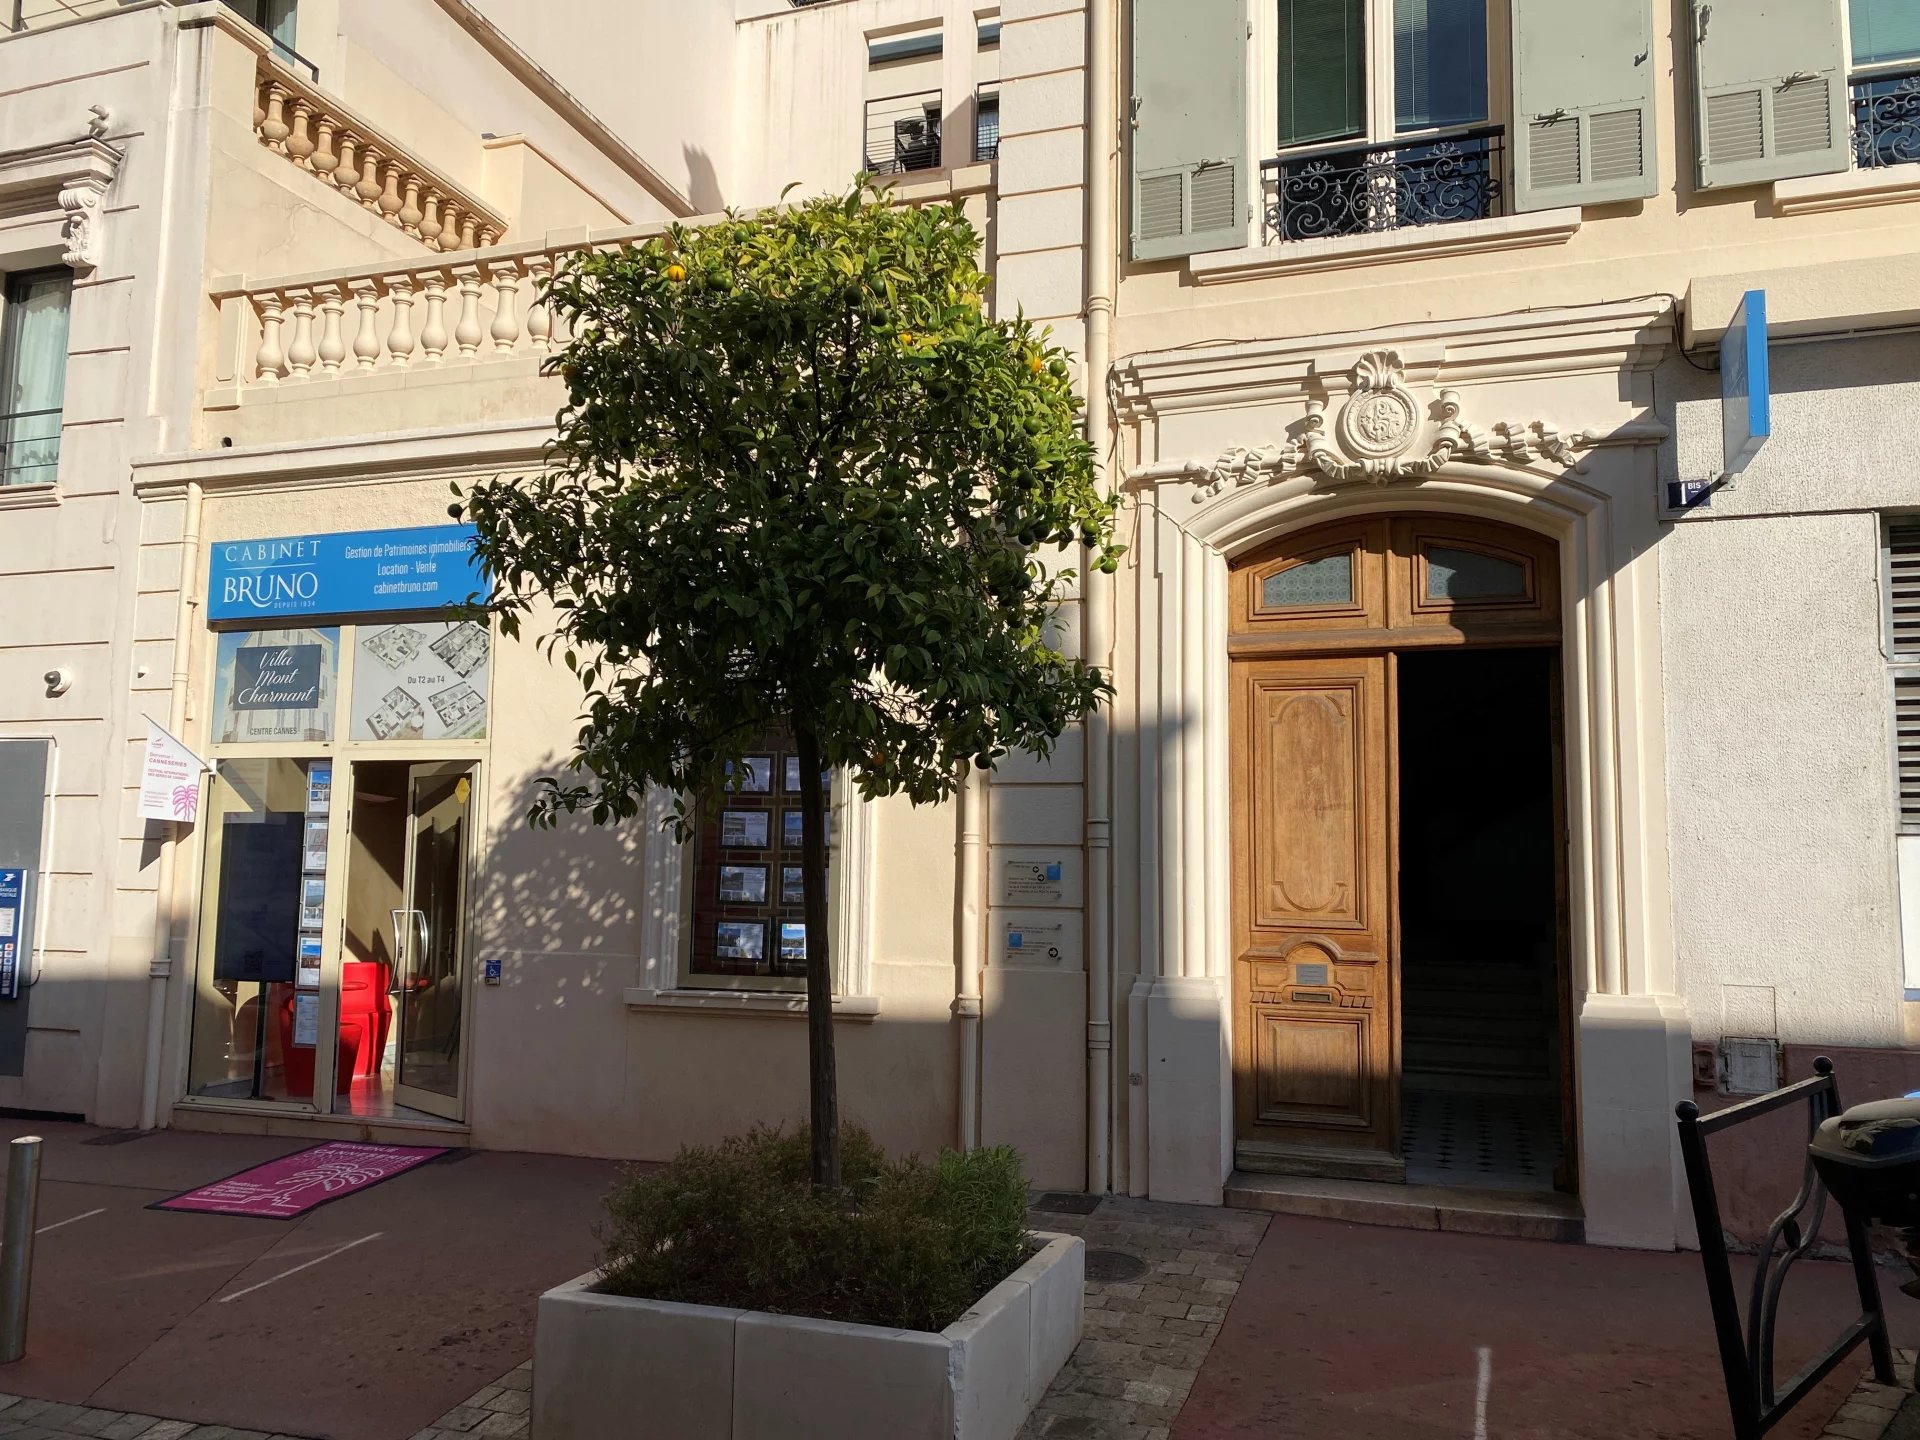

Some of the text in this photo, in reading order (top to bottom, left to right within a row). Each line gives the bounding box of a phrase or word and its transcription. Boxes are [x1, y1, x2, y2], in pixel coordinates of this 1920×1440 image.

[1681, 481, 1702, 505] 1 BIS
[225, 540, 321, 562] CABINET
[345, 539, 472, 559] Gestion de Patrimoines immobiliers
[377, 563, 408, 576] Location
[415, 560, 437, 574] Vente
[223, 571, 319, 608] BRUNO
[373, 581, 438, 595] cabinetbruno.com
[273, 601, 298, 609] DEPUIS
[259, 648, 293, 669] Villa
[255, 668, 299, 687] Mont
[407, 676, 417, 684] Du
[418, 675, 426, 684] T2
[437, 675, 445, 684] T4
[238, 685, 316, 705] Charmant
[249, 726, 298, 736] CENTRE CANNES
